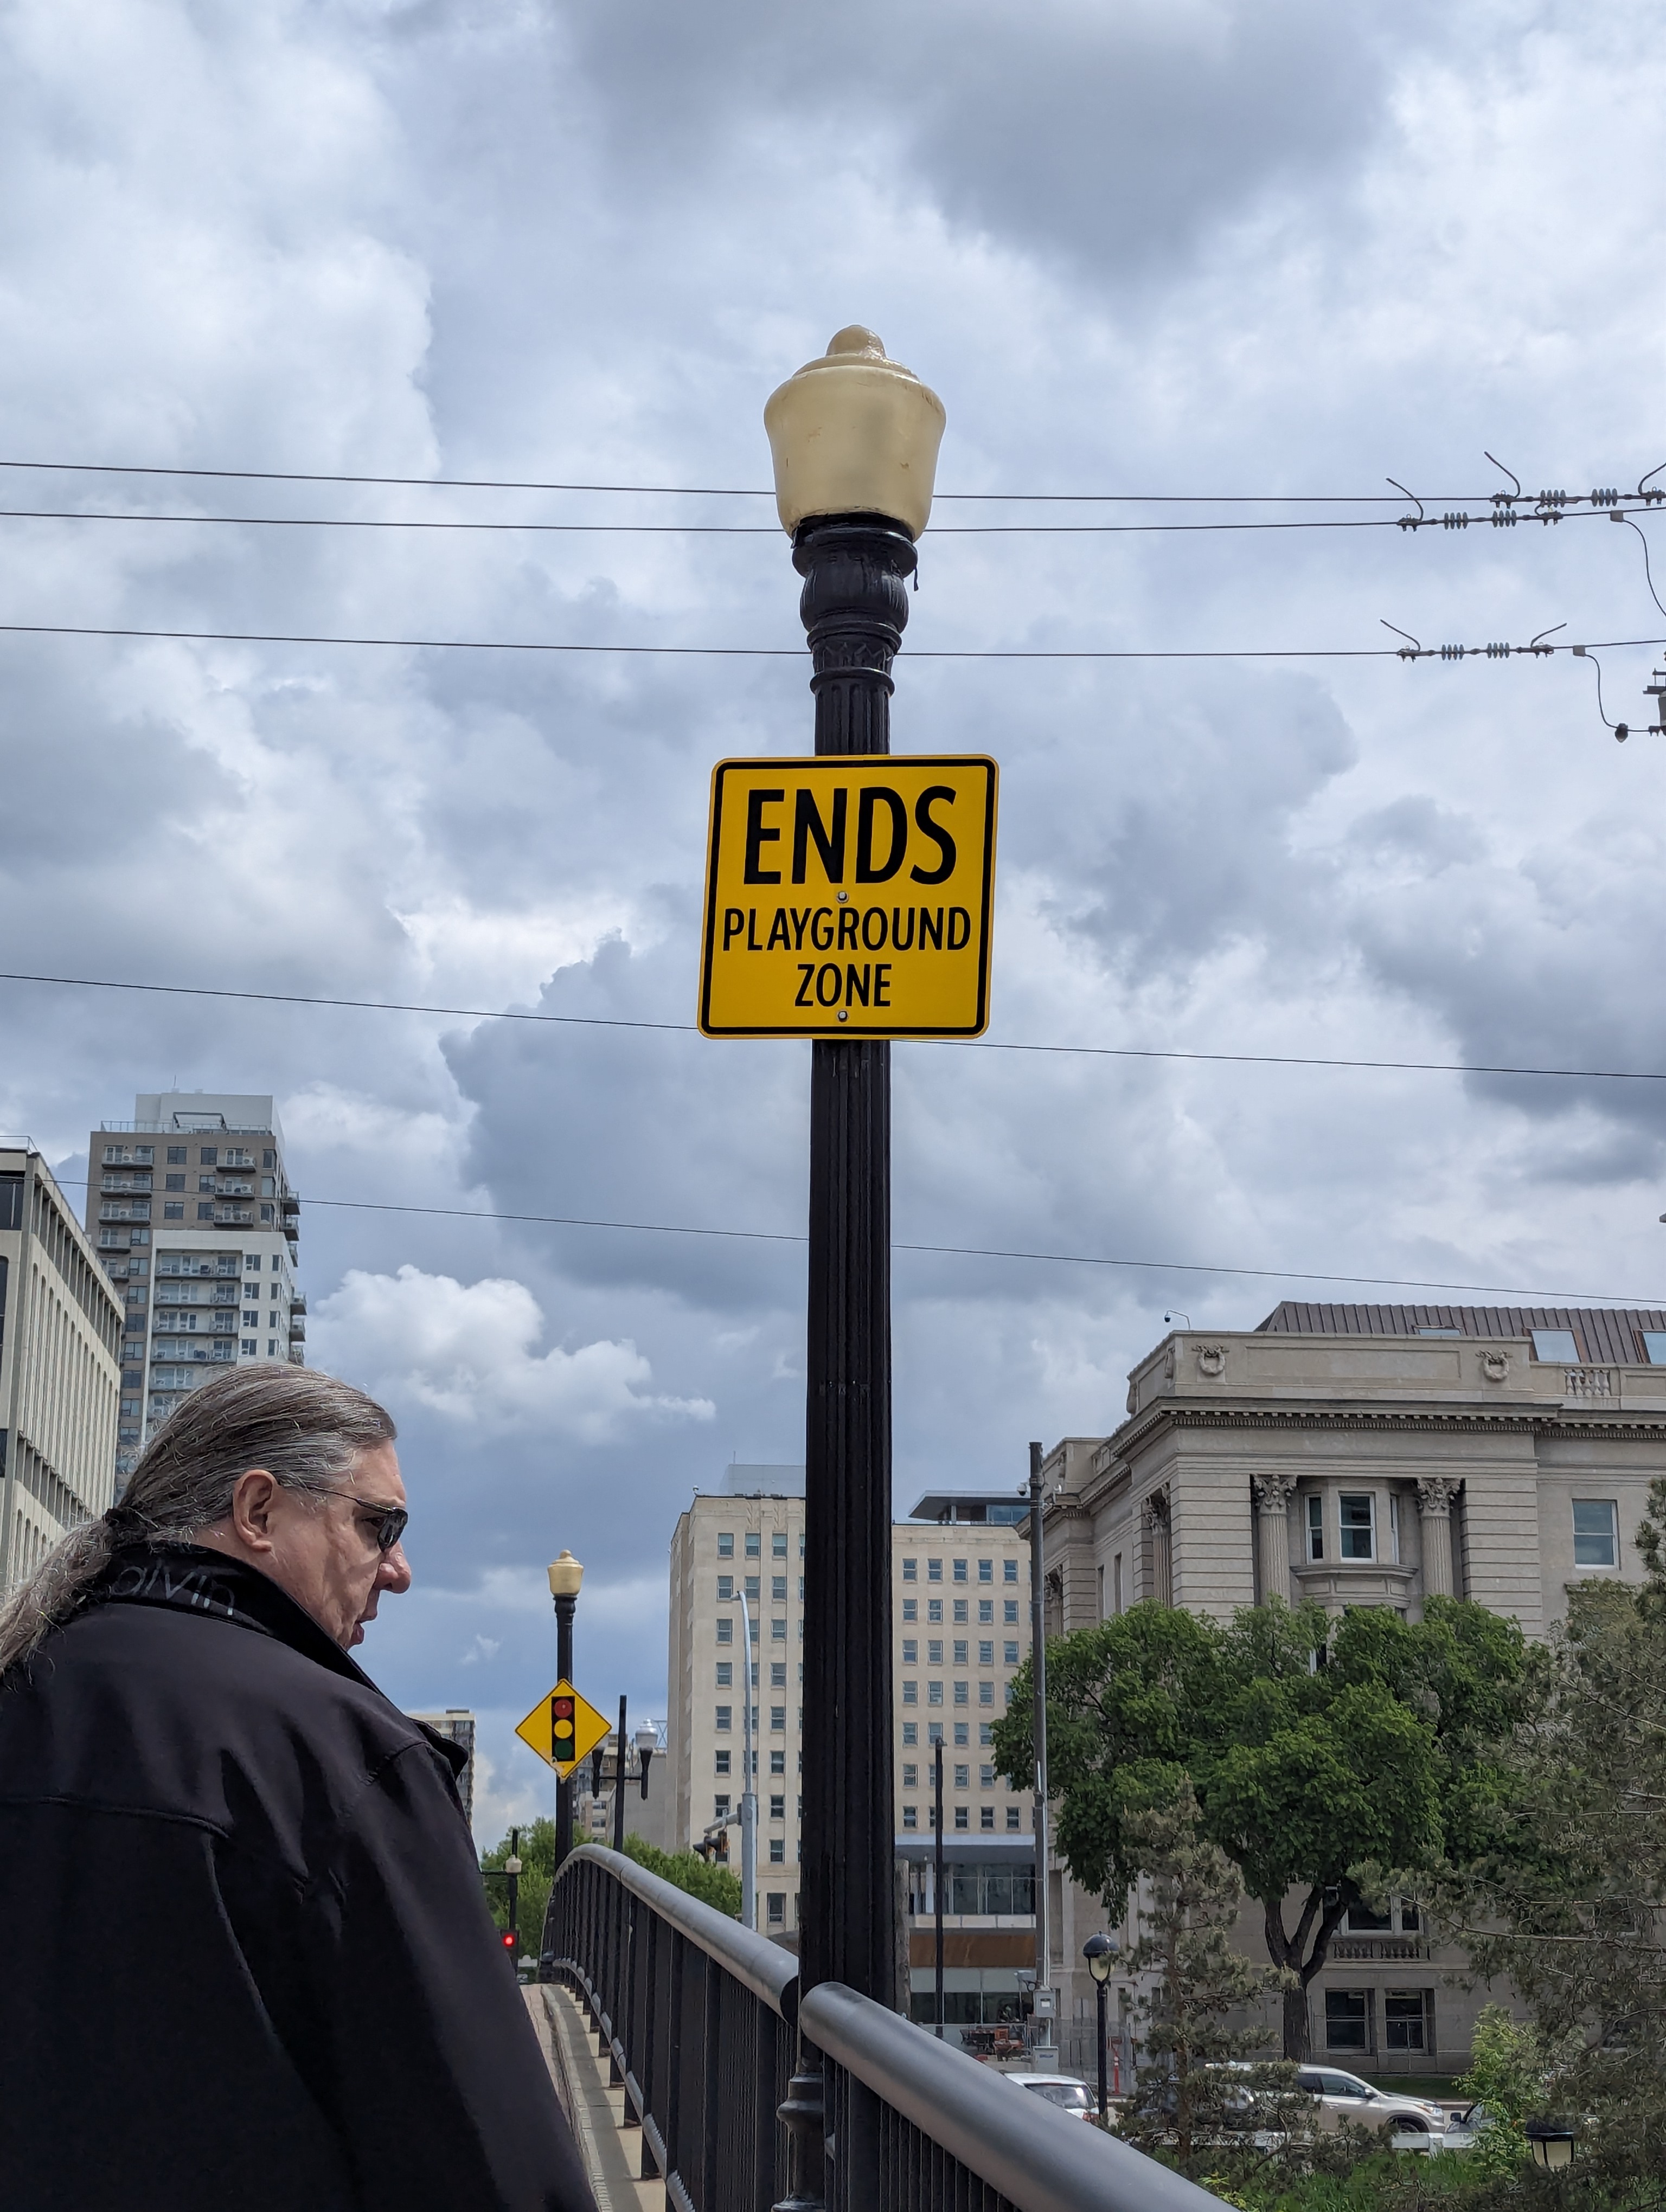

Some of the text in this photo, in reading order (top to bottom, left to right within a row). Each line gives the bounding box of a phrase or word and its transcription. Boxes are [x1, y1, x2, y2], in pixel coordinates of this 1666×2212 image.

[744, 785, 957, 885] ENDS
[723, 906, 971, 951] PLAYGROUND
[794, 963, 892, 1007] ZONE
